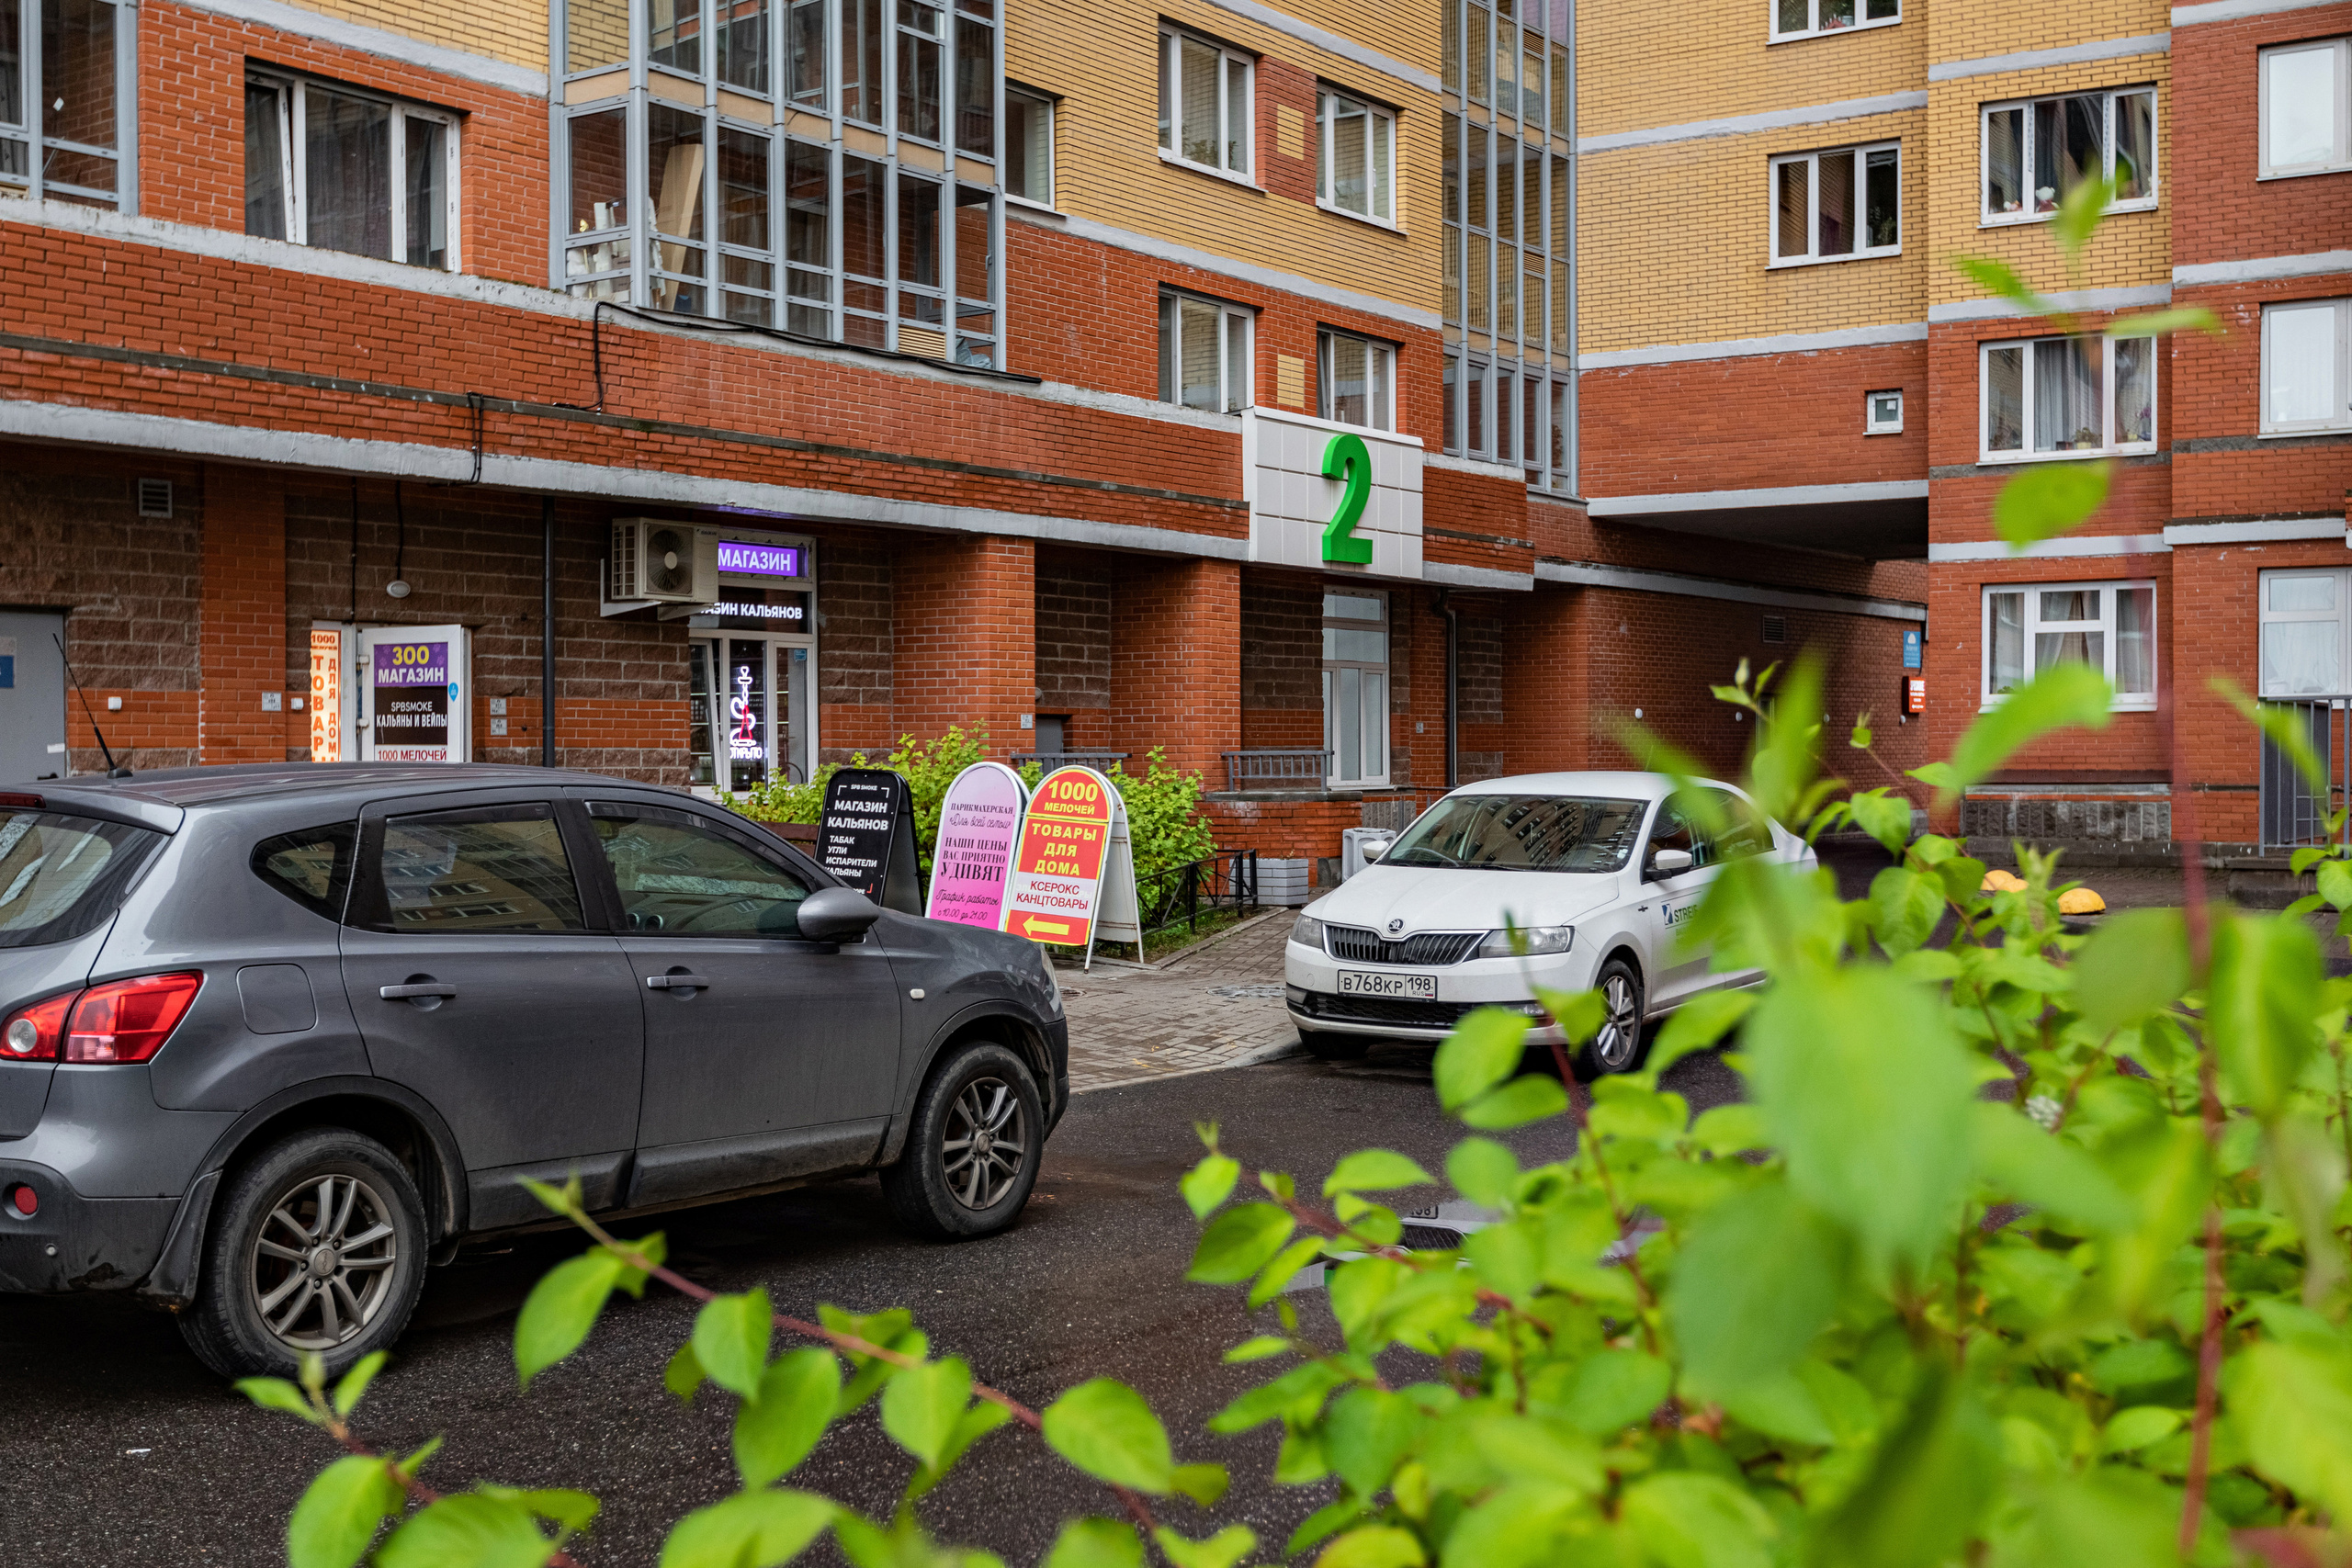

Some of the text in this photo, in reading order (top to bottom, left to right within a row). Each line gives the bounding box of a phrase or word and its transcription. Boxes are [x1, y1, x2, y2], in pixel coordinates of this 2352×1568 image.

[1321, 434, 1374, 564] 2
[718, 548, 791, 571] МАГАЗИН
[741, 604, 803, 620] КАЛЬЯНОВ
[311, 634, 335, 643] 1000
[328, 658, 337, 700] ДЛЯ
[378, 667, 445, 683] МАГАЗИН
[390, 701, 433, 712] SPBSMOKE
[376, 712, 447, 728] КАЛЬЯНЫ И ВЕЙПЫ
[378, 747, 447, 761] 1000 МЕЛОЧЕЙ
[1048, 780, 1098, 802] 1000
[834, 799, 888, 813] МАГАЗИН
[950, 802, 1014, 815] ПАРИКМАХЕРСКАЯ
[1044, 802, 1096, 816] МЕЛОЧЕЙ
[827, 817, 889, 830] КАЛЬЯНОВ
[970, 816, 986, 828] всей
[1032, 823, 1098, 841] ТОВАРЫ
[829, 835, 855, 845] ТАБАК
[944, 837, 1008, 852] НАШИ ЦЕНЫ
[827, 845, 848, 855] УГЛИ
[943, 850, 1006, 864] ВАС ПРИЯТНО
[1044, 842, 1078, 858] ДЛЯ
[825, 856, 877, 868] ИСПАРИТЕЛИ
[1034, 859, 1080, 876] ДОМА
[941, 862, 1004, 882] УДИВЯТ
[1030, 880, 1080, 896] КСЕРОКС
[935, 888, 1000, 906] График работы
[1016, 892, 1089, 910] КАНЦТОВАРЫ
[942, 908, 960, 918] 10.00
[960, 912, 968, 920] до
[969, 910, 988, 920] 21.00
[1407, 976, 1431, 991] 198
